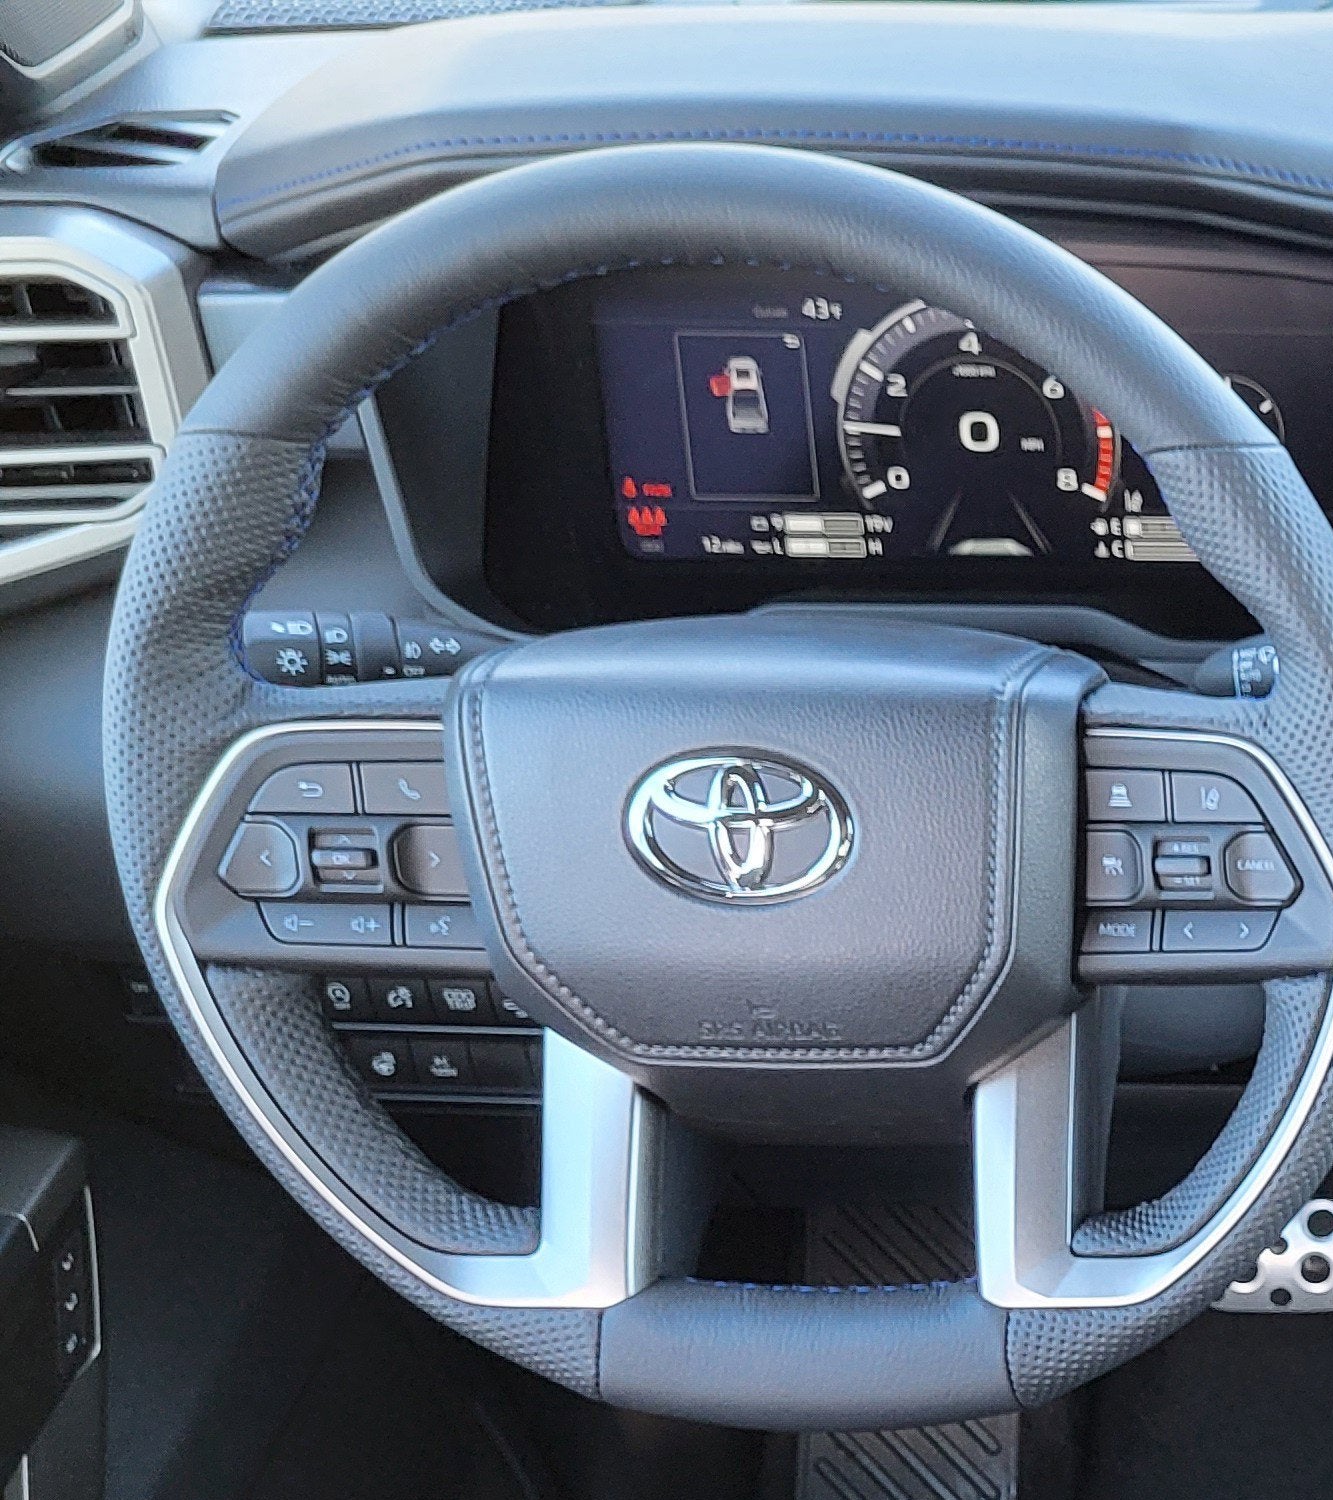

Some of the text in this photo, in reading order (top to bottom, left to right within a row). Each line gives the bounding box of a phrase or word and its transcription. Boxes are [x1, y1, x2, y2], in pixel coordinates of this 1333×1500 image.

[958, 331, 982, 356] 4
[886, 373, 907, 397] 2
[1042, 375, 1065, 399] 6
[959, 411, 1000, 453] 0
[887, 466, 910, 490] 0
[1056, 467, 1078, 491] 8
[1236, 858, 1276, 872] CANCEL
